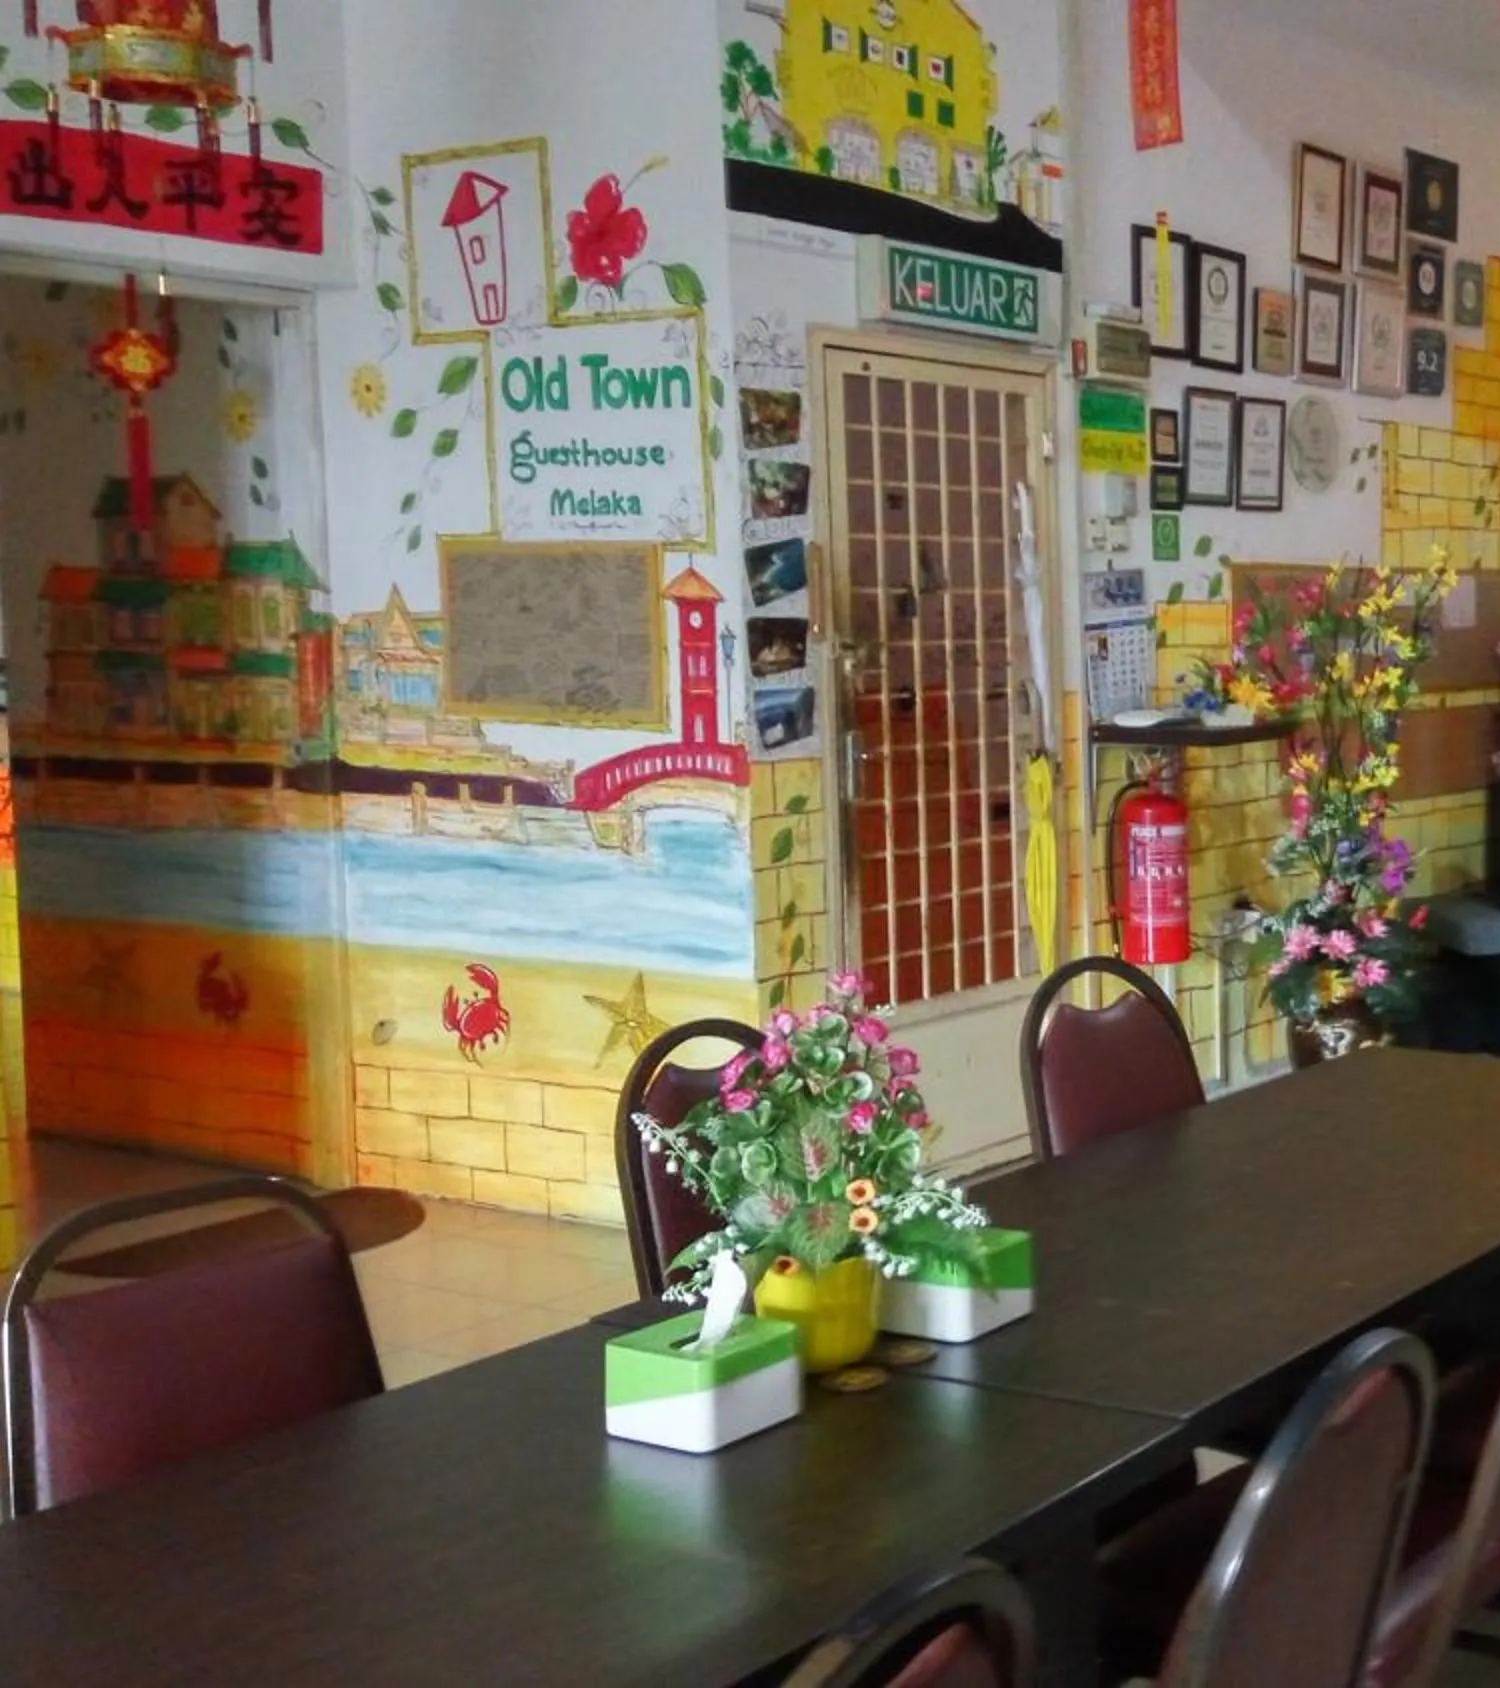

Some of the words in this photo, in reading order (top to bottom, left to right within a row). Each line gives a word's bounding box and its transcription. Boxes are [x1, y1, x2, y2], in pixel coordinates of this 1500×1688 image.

[894, 253, 1009, 322] KELUAR
[502, 354, 569, 413] Old
[578, 353, 691, 411] Town
[1417, 350, 1439, 373] 9.2
[510, 429, 666, 484] guesthouse
[550, 487, 643, 517] Melaka
